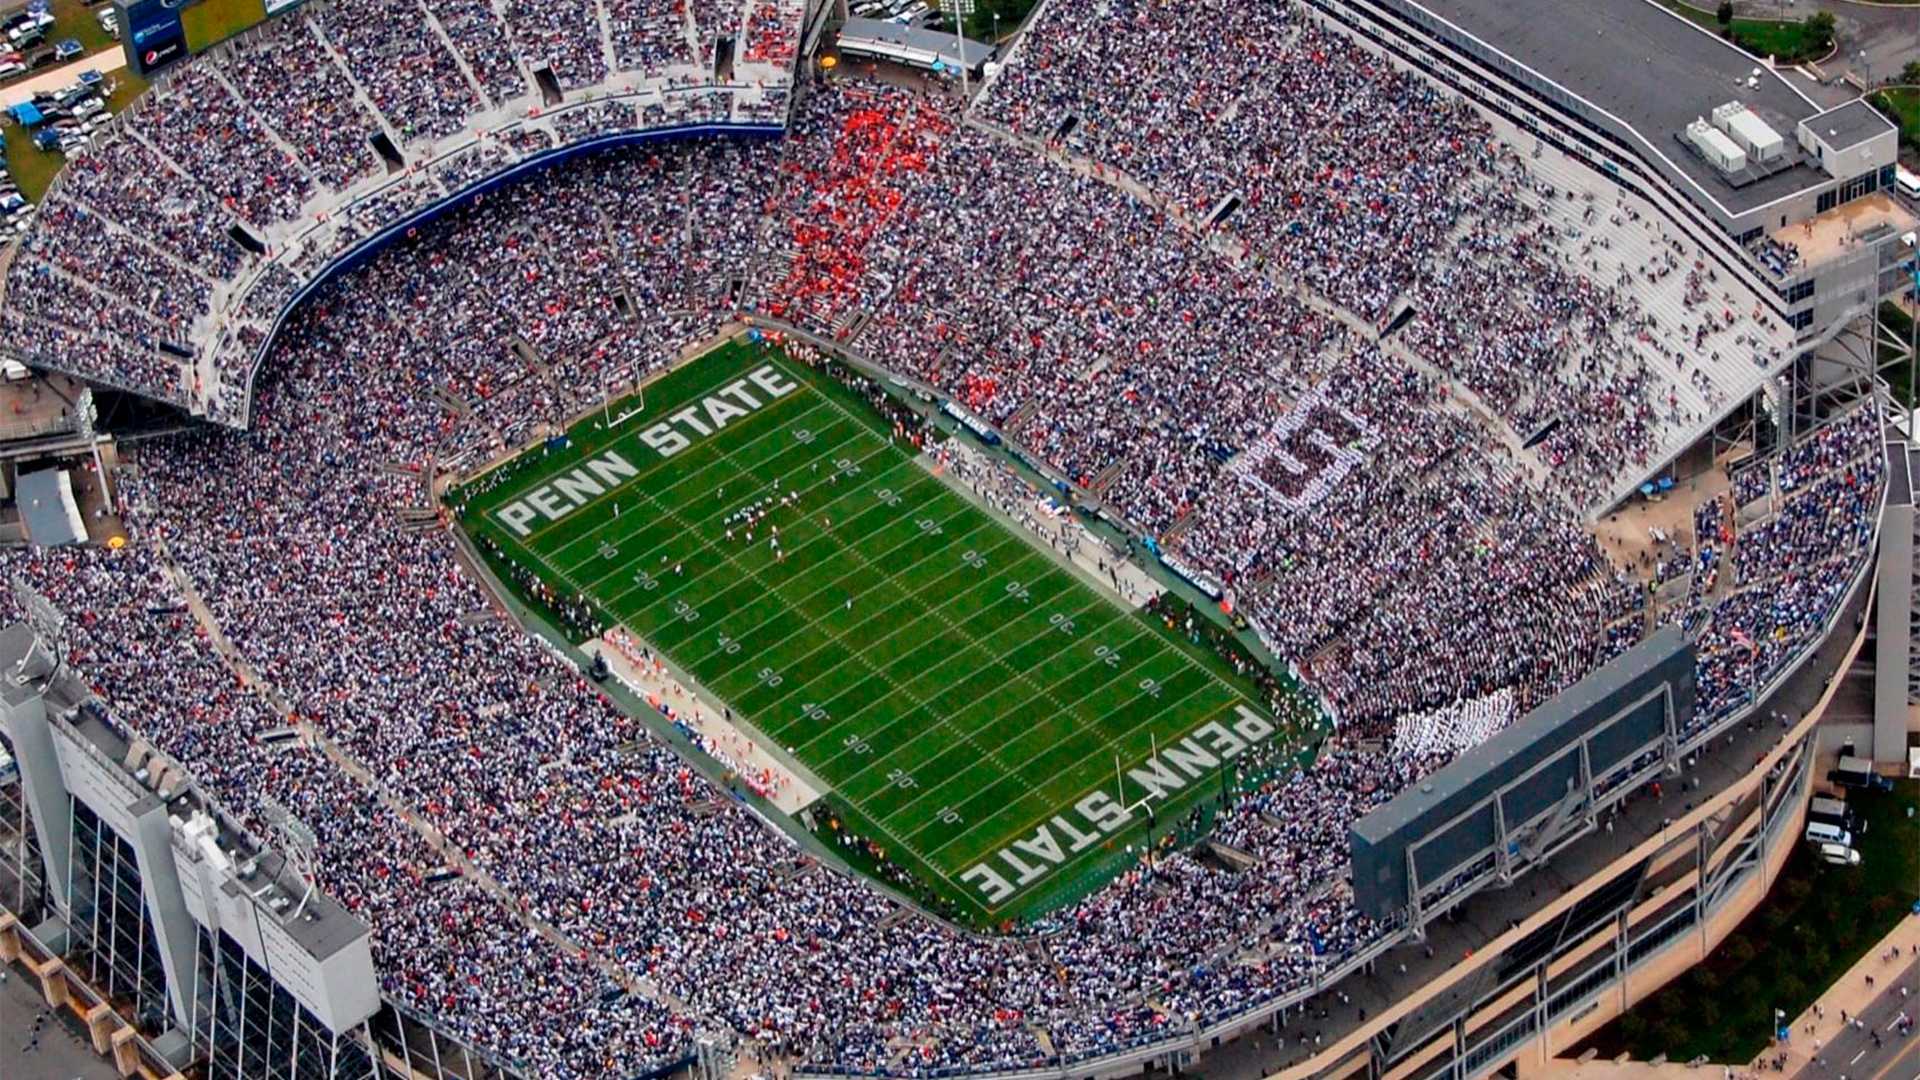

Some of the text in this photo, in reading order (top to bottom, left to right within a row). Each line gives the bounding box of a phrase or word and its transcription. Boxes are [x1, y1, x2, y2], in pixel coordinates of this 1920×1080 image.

[497, 365, 798, 537] PENN STATE
[960, 704, 1276, 905] PENN STATE
